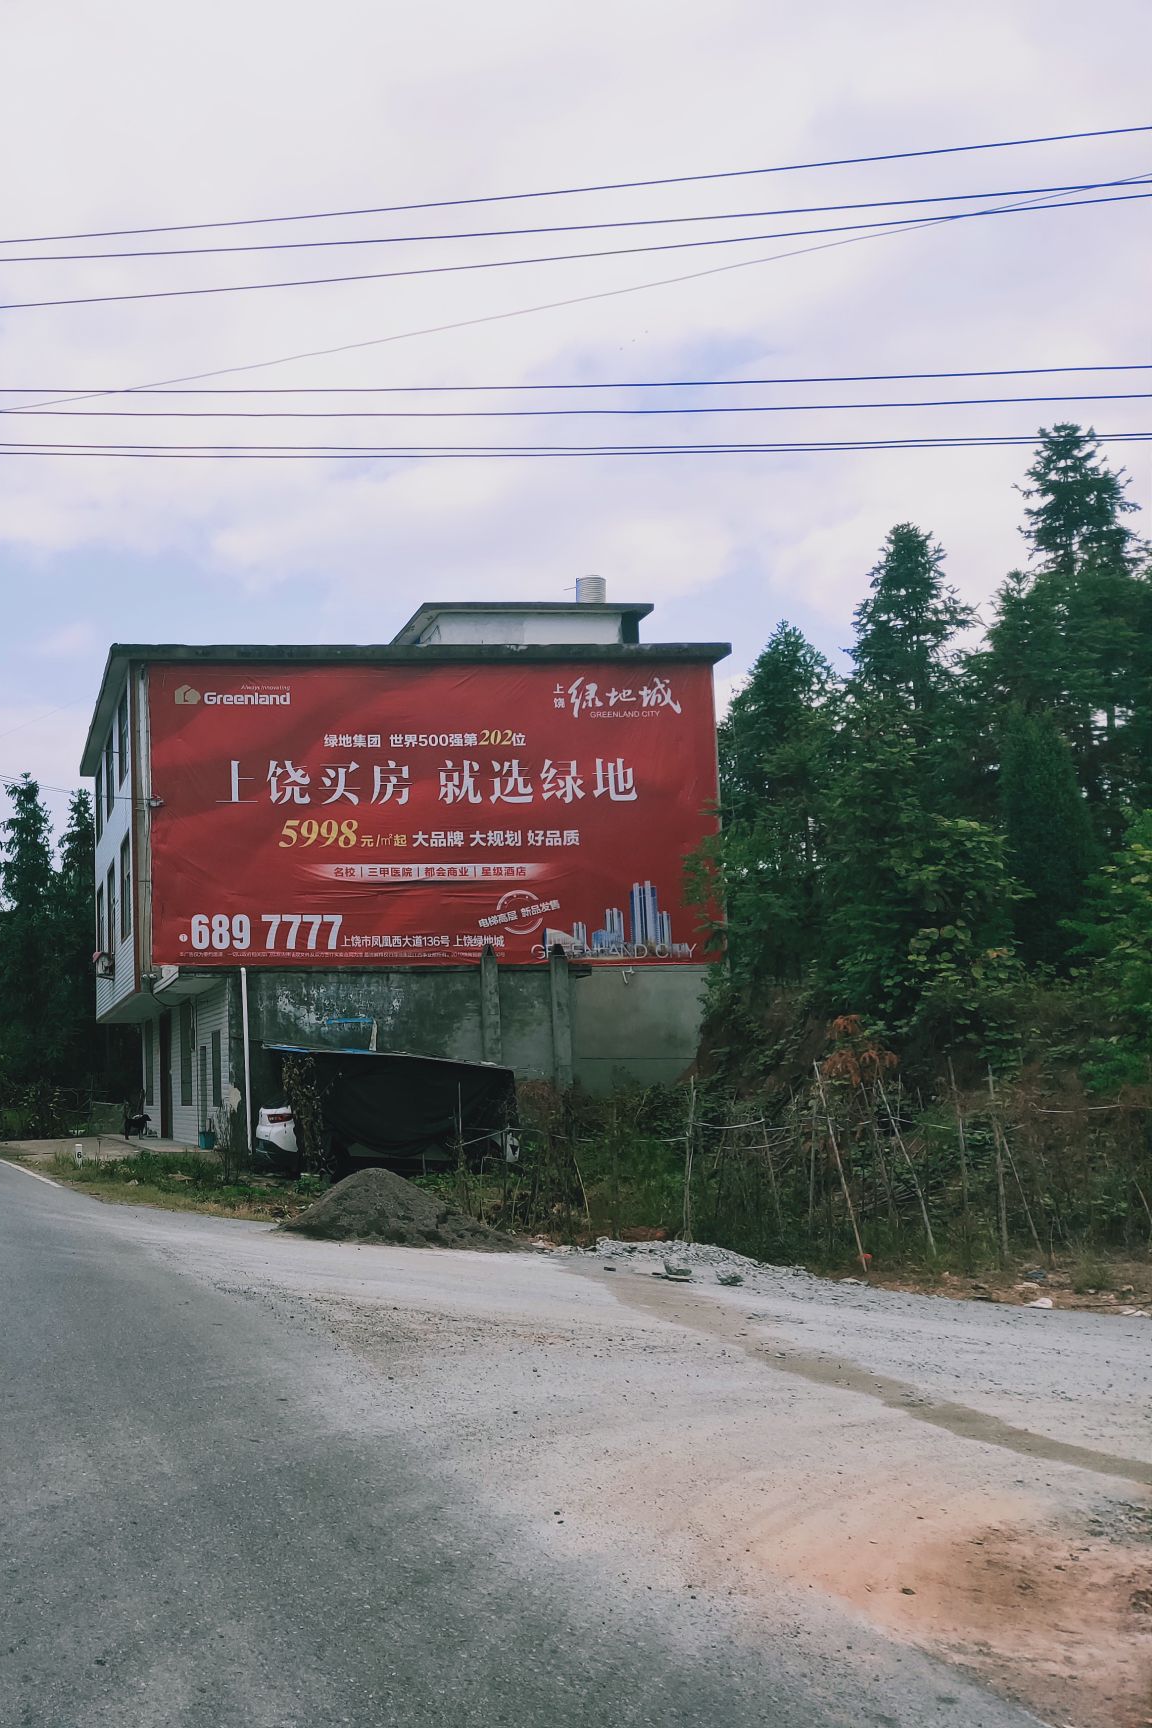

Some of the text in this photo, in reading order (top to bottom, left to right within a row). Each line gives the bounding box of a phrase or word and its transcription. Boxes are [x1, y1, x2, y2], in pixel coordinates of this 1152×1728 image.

[203, 692, 291, 705] Greenland
[553, 683, 566, 709] 上饶
[590, 710, 661, 719] GREENLAND CITY
[324, 730, 526, 748] 绿地集团 世界500强第202位
[215, 757, 638, 806] 上饶买房 就选绿地
[278, 819, 359, 848] 5998
[412, 831, 465, 848] 大品牌
[469, 830, 522, 847] 大规划
[527, 829, 580, 846] 好品质
[334, 866, 527, 878] 名校 三甲医院 都会商业 星级酒店
[478, 910, 518, 928] 电梯高层
[190, 914, 343, 950] 689 7777
[453, 935, 505, 948] 上饶绿地城
